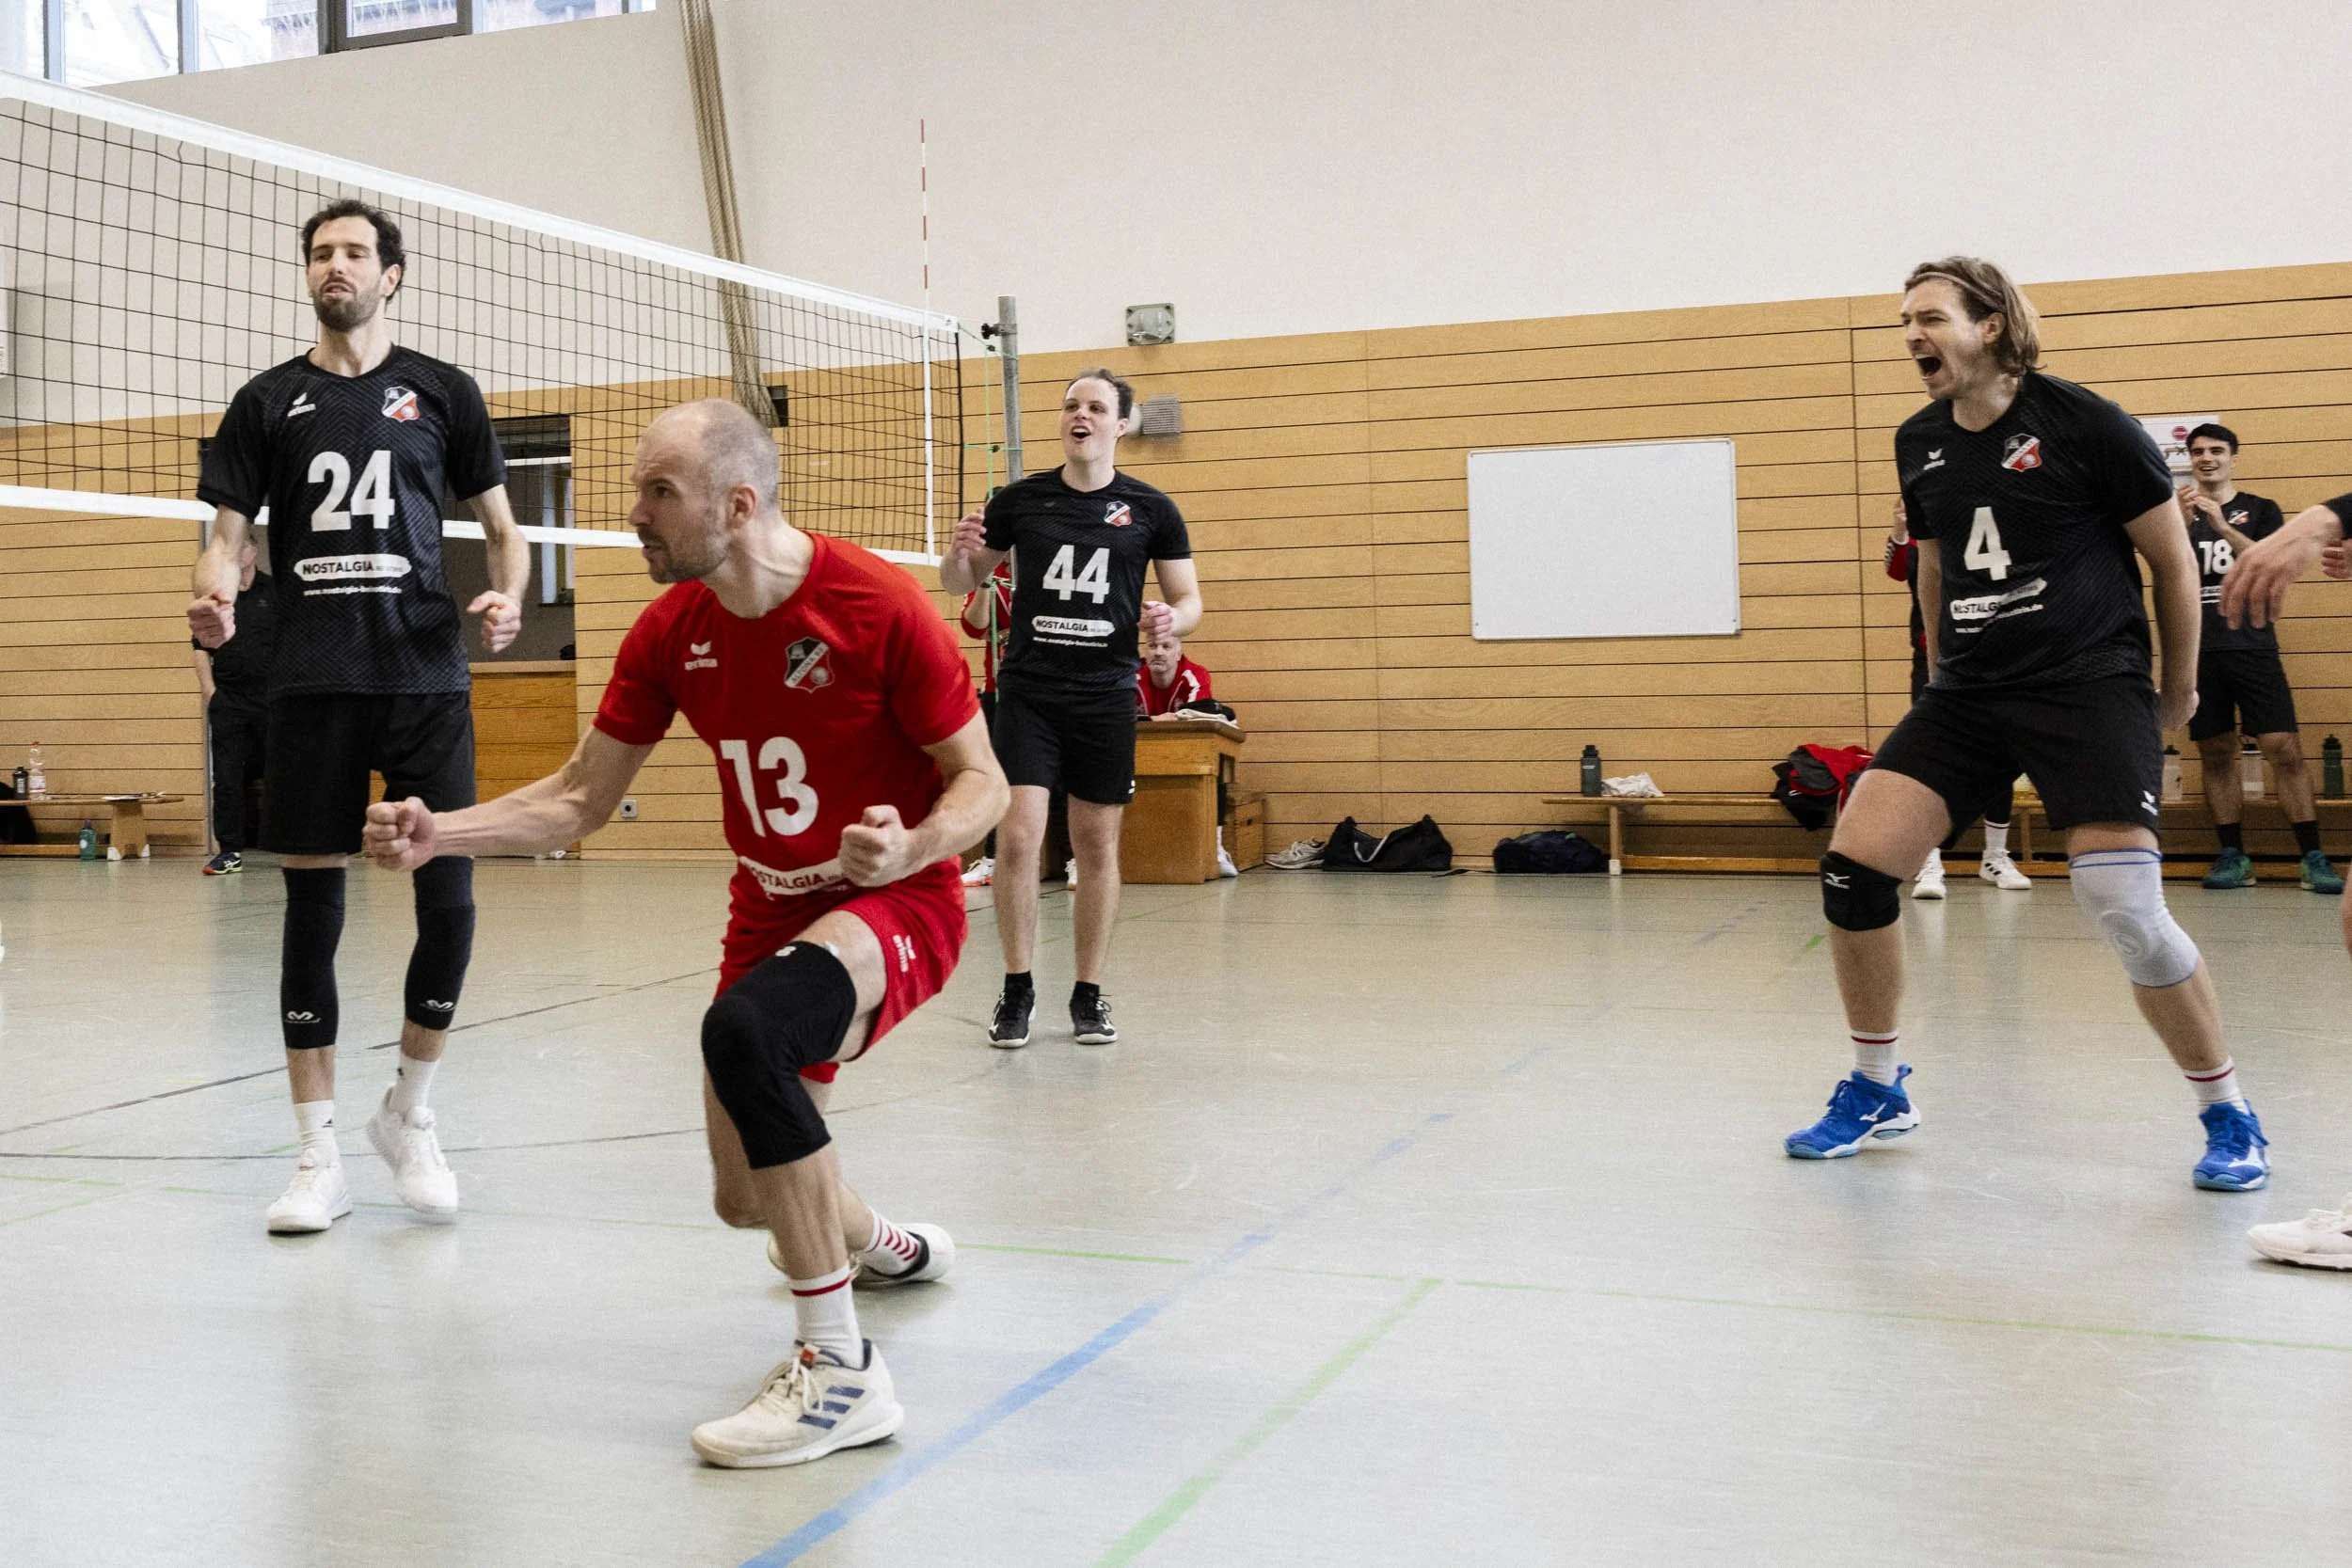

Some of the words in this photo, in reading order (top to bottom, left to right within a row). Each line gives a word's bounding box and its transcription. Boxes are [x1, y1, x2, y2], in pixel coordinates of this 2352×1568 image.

[308, 450, 395, 531] 24
[302, 562, 374, 575] NOSTALGIA
[1963, 506, 2012, 580] 4
[2199, 539, 2236, 575] 18
[1042, 545, 1110, 604] 44
[1036, 619, 1089, 632] NOSTALGIA
[720, 736, 819, 837] 13
